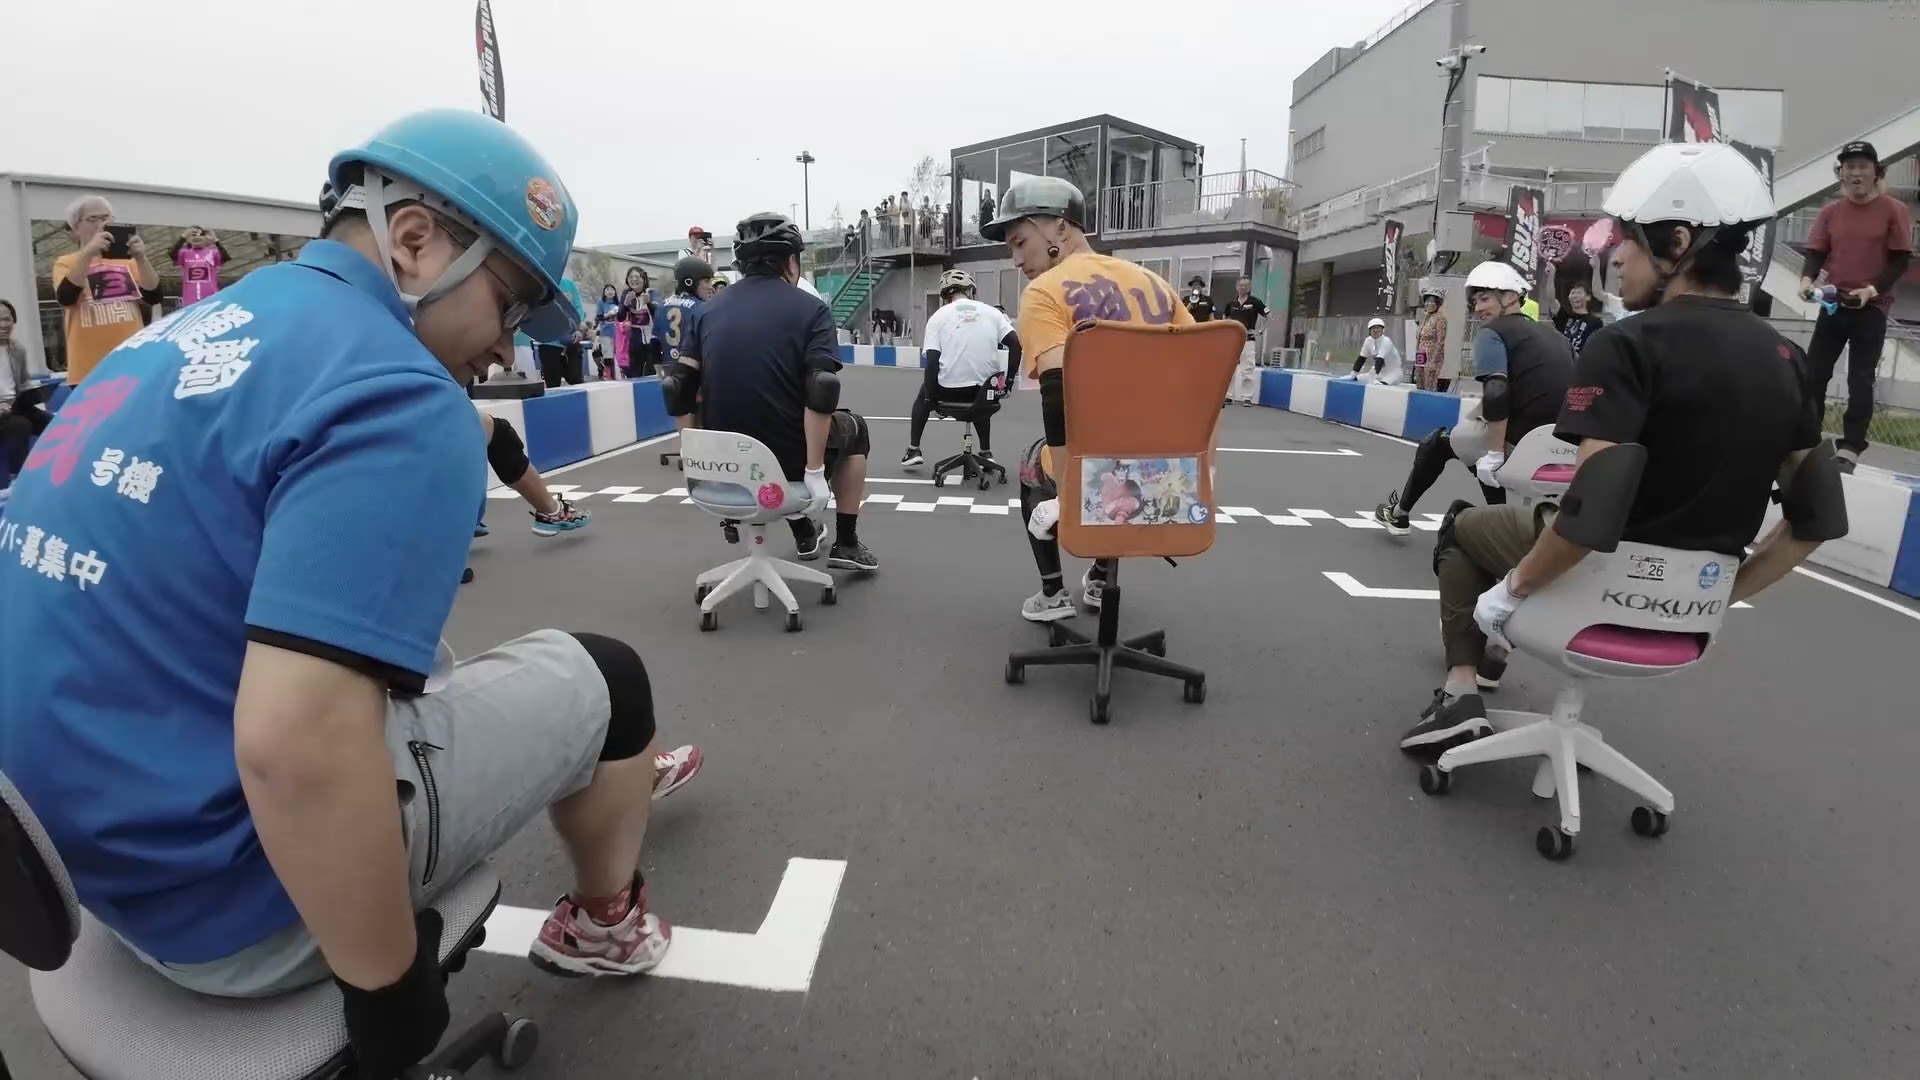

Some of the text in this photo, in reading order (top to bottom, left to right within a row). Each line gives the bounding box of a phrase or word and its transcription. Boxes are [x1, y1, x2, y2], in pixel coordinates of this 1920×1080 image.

[665, 307, 681, 347] 3
[1648, 564, 1664, 577] 26
[1602, 589, 1721, 616] KOKUYO
